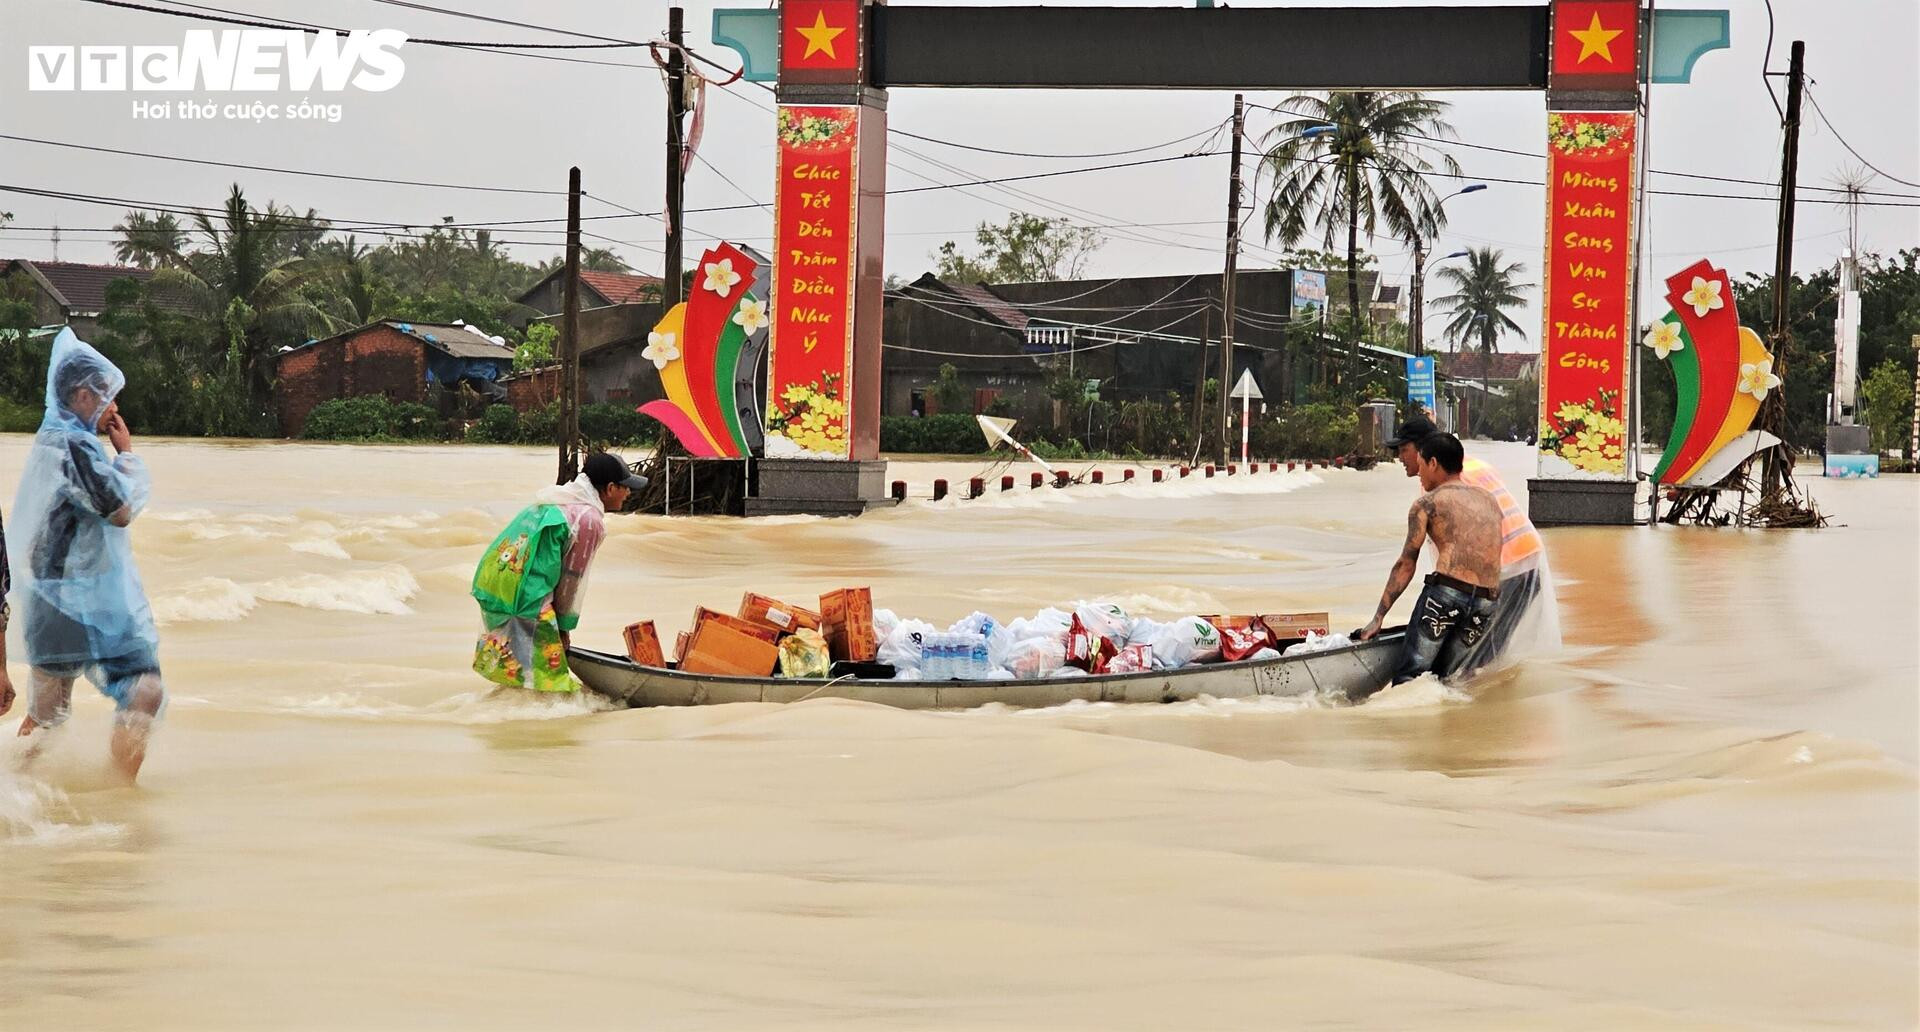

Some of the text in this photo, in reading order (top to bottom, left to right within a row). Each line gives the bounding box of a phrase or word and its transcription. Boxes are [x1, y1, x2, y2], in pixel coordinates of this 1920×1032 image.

[793, 163, 841, 180] Chúc
[1562, 171, 1618, 193] Mừng
[800, 190, 831, 209] Tết
[1563, 201, 1616, 219] Xuân
[798, 218, 833, 238] Đến
[1563, 231, 1613, 253] Sang
[790, 249, 838, 266] Trăm
[1569, 261, 1607, 282] Vạn
[792, 275, 835, 295] Điều
[1571, 291, 1601, 312] Sự
[790, 306, 832, 324] Như
[1555, 321, 1617, 340] Thành
[1559, 351, 1610, 374] Công
